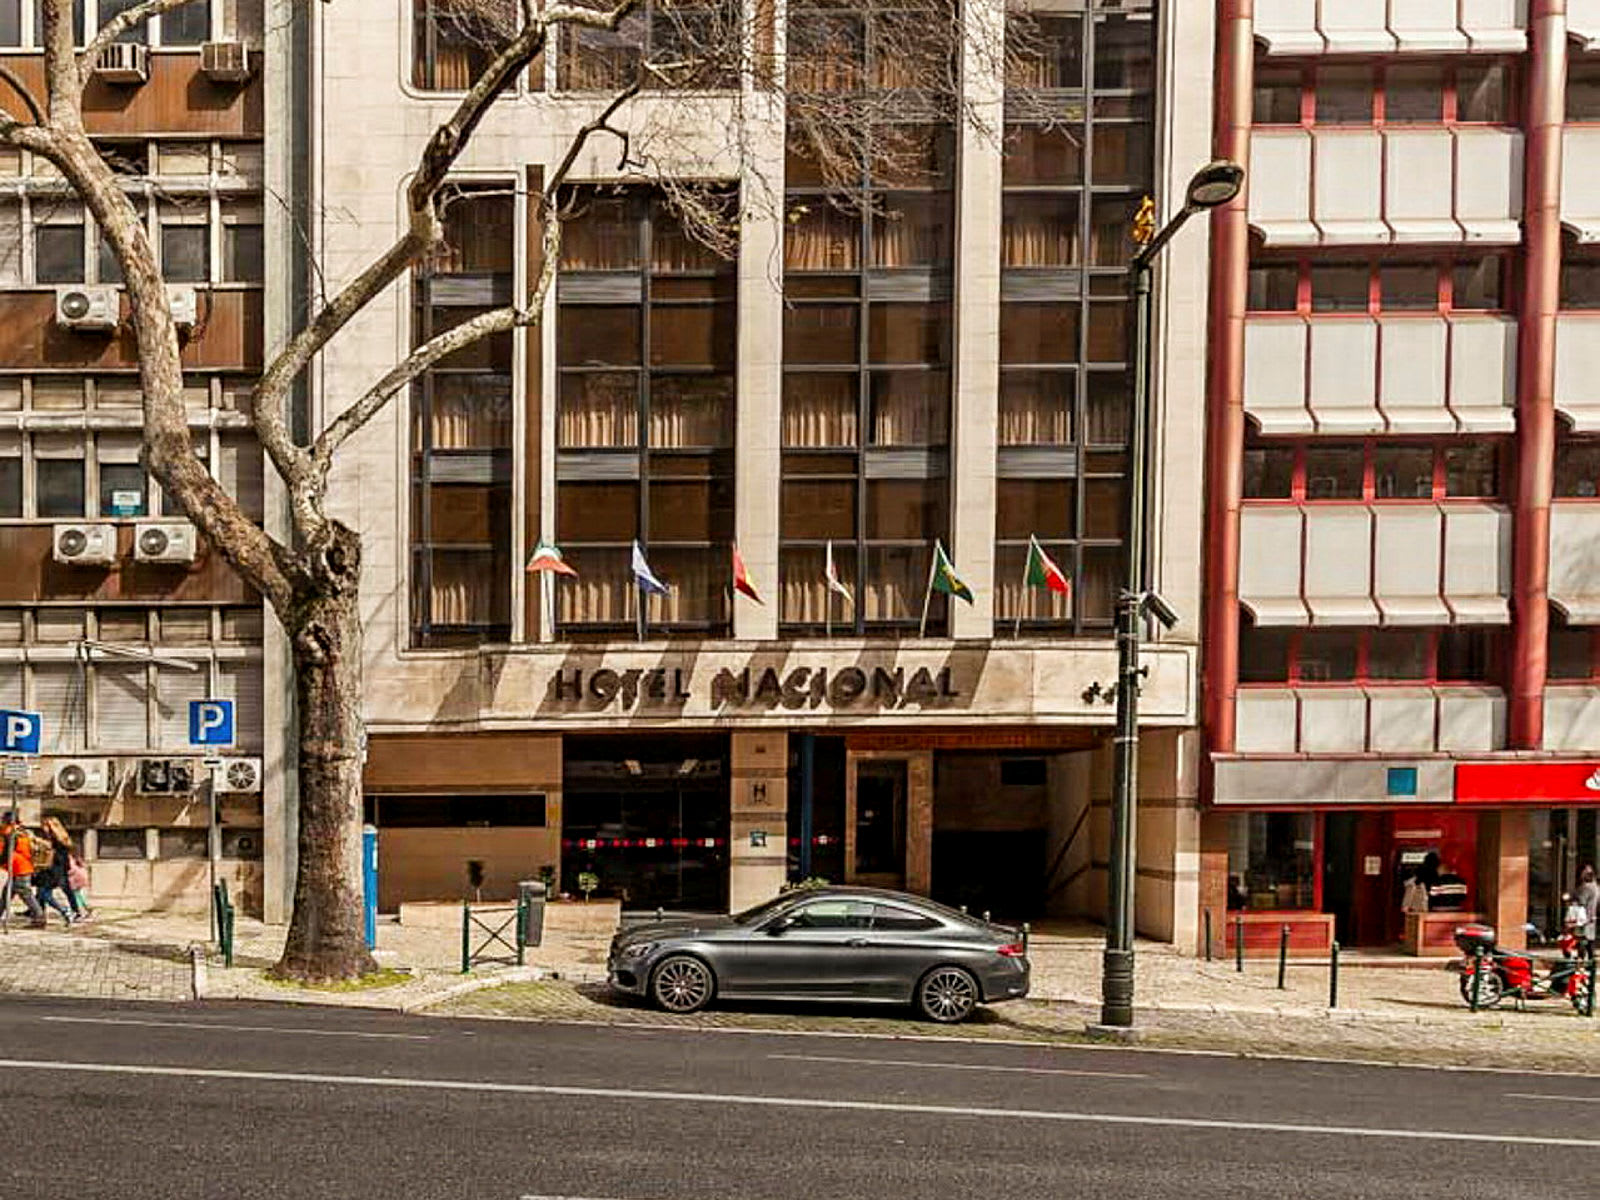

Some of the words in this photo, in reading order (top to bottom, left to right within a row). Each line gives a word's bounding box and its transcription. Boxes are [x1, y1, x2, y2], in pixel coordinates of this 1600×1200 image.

[554, 668, 691, 703] HOTEL
[713, 667, 959, 705] NACIONAL
[6, 716, 32, 748] P
[198, 704, 225, 741] P
